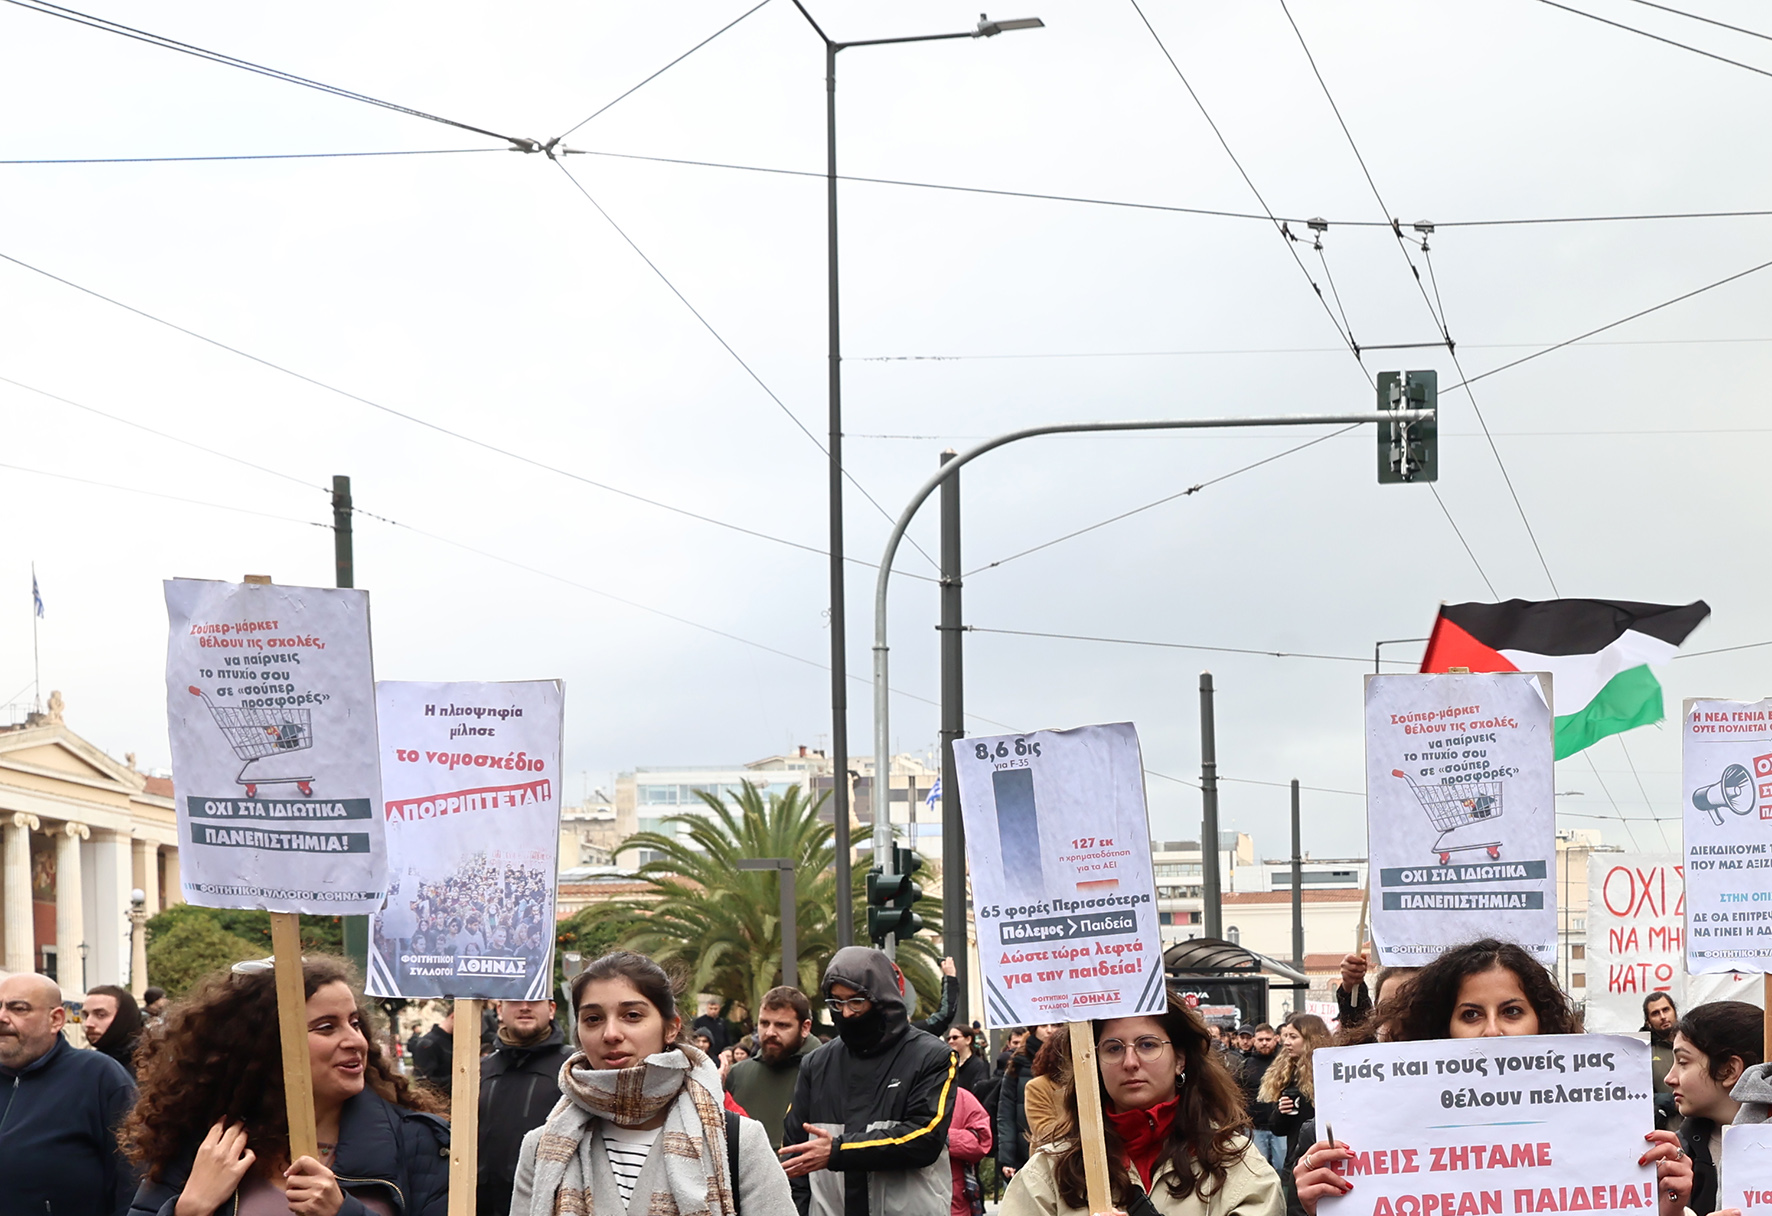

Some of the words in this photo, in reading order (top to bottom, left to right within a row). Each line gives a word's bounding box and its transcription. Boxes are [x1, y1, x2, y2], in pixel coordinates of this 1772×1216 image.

[200, 636, 244, 648] θέλουν
[247, 639, 263, 650] τις
[267, 635, 326, 649] σχολές,
[425, 705, 435, 716] Η
[440, 704, 523, 720] πλειοψηφία
[450, 723, 495, 740] μίλησε
[396, 749, 419, 762] το
[426, 752, 544, 772] νομοσχέδιο
[975, 742, 1009, 762] 8,6
[1015, 738, 1041, 757] δις
[994, 762, 1007, 771] για
[1010, 759, 1029, 767] F-35
[205, 801, 232, 815] ΟΧΙ
[238, 802, 265, 816] ΣΤΑ
[269, 803, 347, 817] ΙΔΙΩΤΙΚΑ
[387, 783, 551, 823] ΑΠΟΡΡΙΠΤΕΤΑΙ!
[205, 828, 349, 851] ΠΑΝΕΠΙΣΤΗΜΙΑ!
[1072, 838, 1095, 849] 127
[1100, 837, 1114, 847] εκ
[1066, 850, 1130, 862] χρηματοδότηση
[1103, 862, 1117, 870] ΑΕΙ
[1401, 870, 1428, 882] ΟΧΙ
[1432, 869, 1457, 881] ΣΤΑ
[1461, 865, 1527, 880] ΙΔΙΩΤΙΚΑ
[981, 905, 1000, 918] 65
[1005, 902, 1050, 918] φορές
[1053, 893, 1150, 913] Περισσότερα
[1401, 894, 1527, 908] ΠΑΝΕΠΙΣΤΗΜΙΑ!
[1002, 923, 1063, 939] Πόλεμος
[1081, 915, 1132, 932] Παιδεία
[1000, 950, 1048, 965] Δώστε
[1052, 946, 1090, 961] τώρα
[1095, 938, 1143, 956] λεφτά
[1609, 926, 1639, 954] ΝΑ
[401, 955, 453, 963] ΦΟΙΤΗΤΙΚΟΙ
[458, 959, 526, 974] ΑΘΗΝΑΣ
[409, 967, 452, 976] ΣΥΛΛΟΓΟΙ
[1003, 972, 1032, 989] για
[1037, 969, 1063, 982] την
[1069, 958, 1142, 979] παιδεία!
[1608, 963, 1673, 994] ΚΑΤΩ
[1333, 1059, 1384, 1082] Εμάς
[1393, 1061, 1428, 1076] και
[1435, 1057, 1488, 1078] τους
[1495, 1050, 1565, 1076] γονείς
[1573, 1051, 1615, 1072] μας
[1441, 1088, 1522, 1109] θέλουν
[1530, 1085, 1647, 1104] πελατεία...
[1429, 1142, 1552, 1172] ΖΗΤΑΜΕ
[1514, 1183, 1653, 1213] ΠΑΙΔΕΙΑ!
